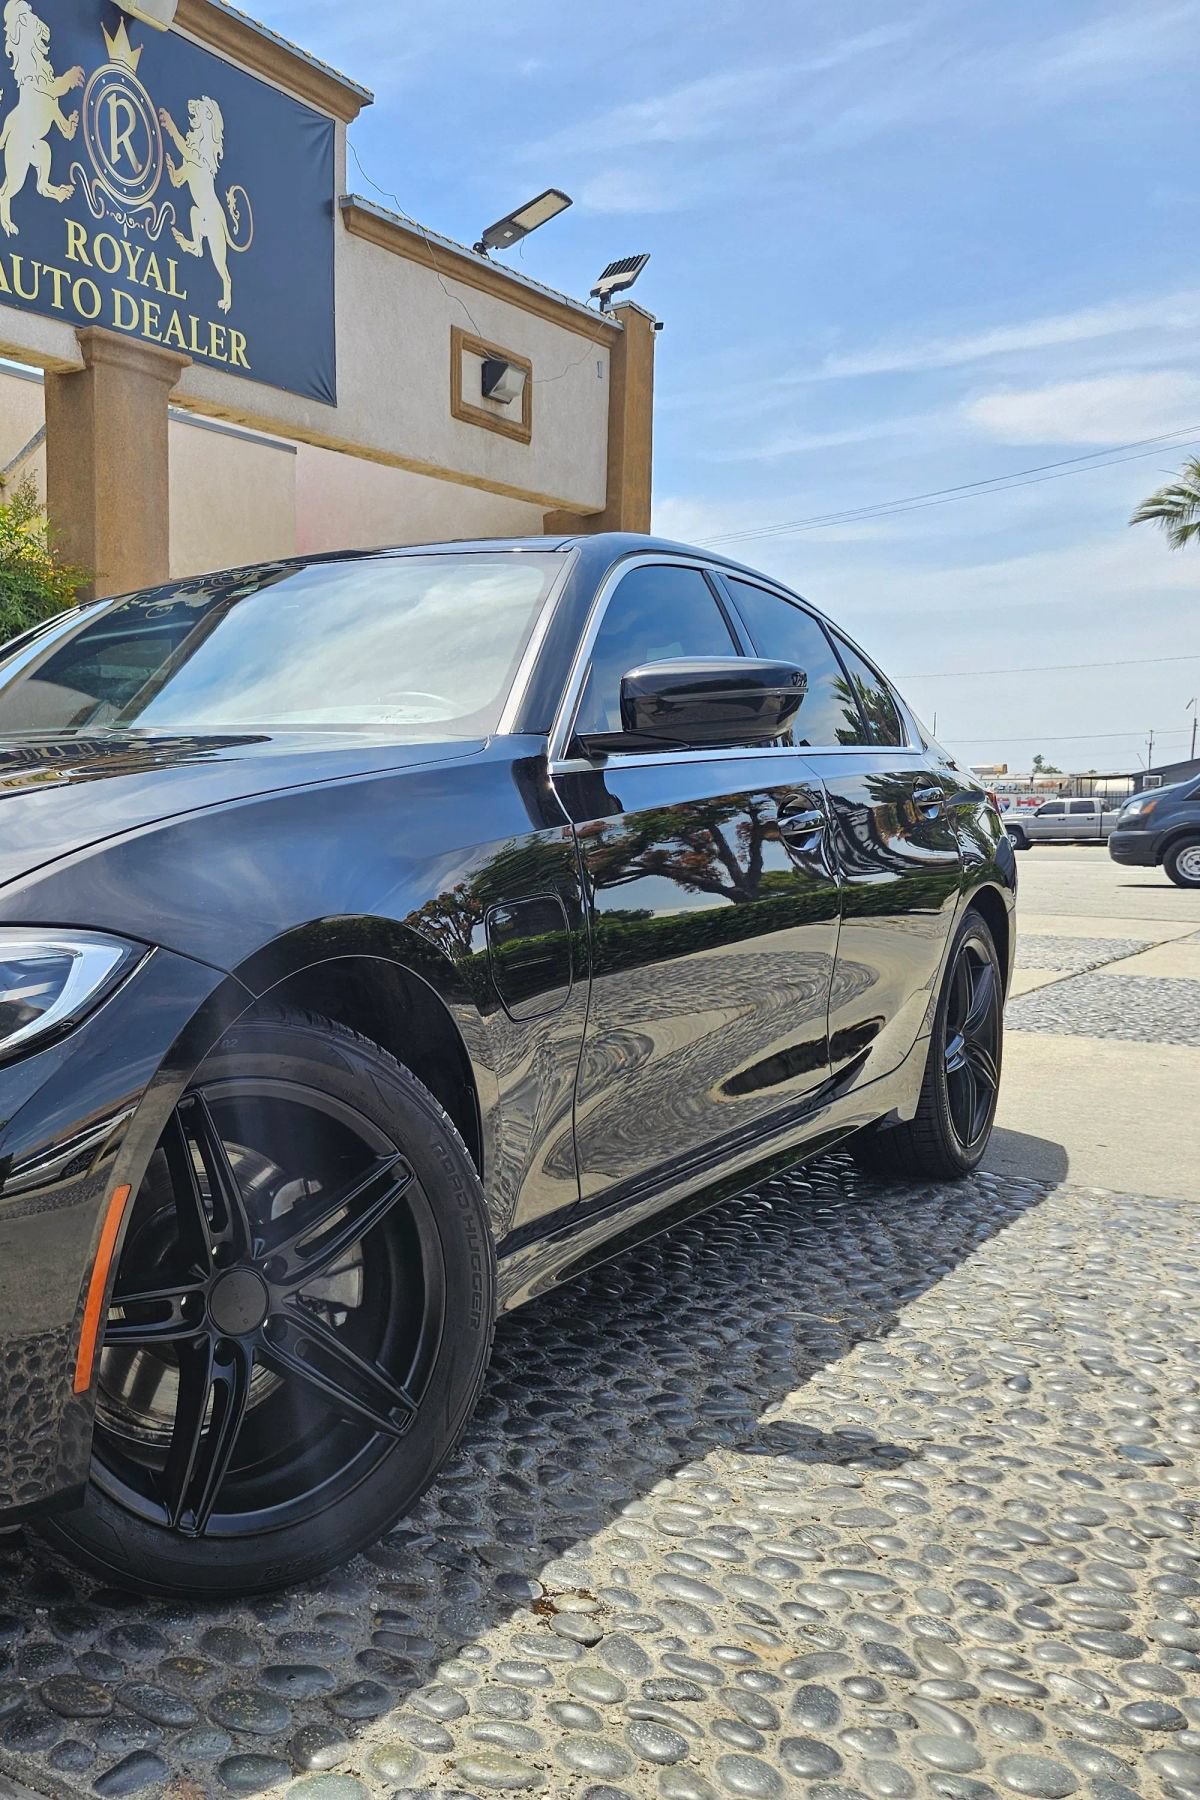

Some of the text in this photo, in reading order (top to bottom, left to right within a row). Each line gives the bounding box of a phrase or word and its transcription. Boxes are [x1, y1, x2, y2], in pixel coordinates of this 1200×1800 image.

[108, 93, 143, 173] R
[64, 217, 188, 301] ROYAL
[112, 288, 252, 370] DEALER
[462, 1214, 484, 1331] HUGGER
